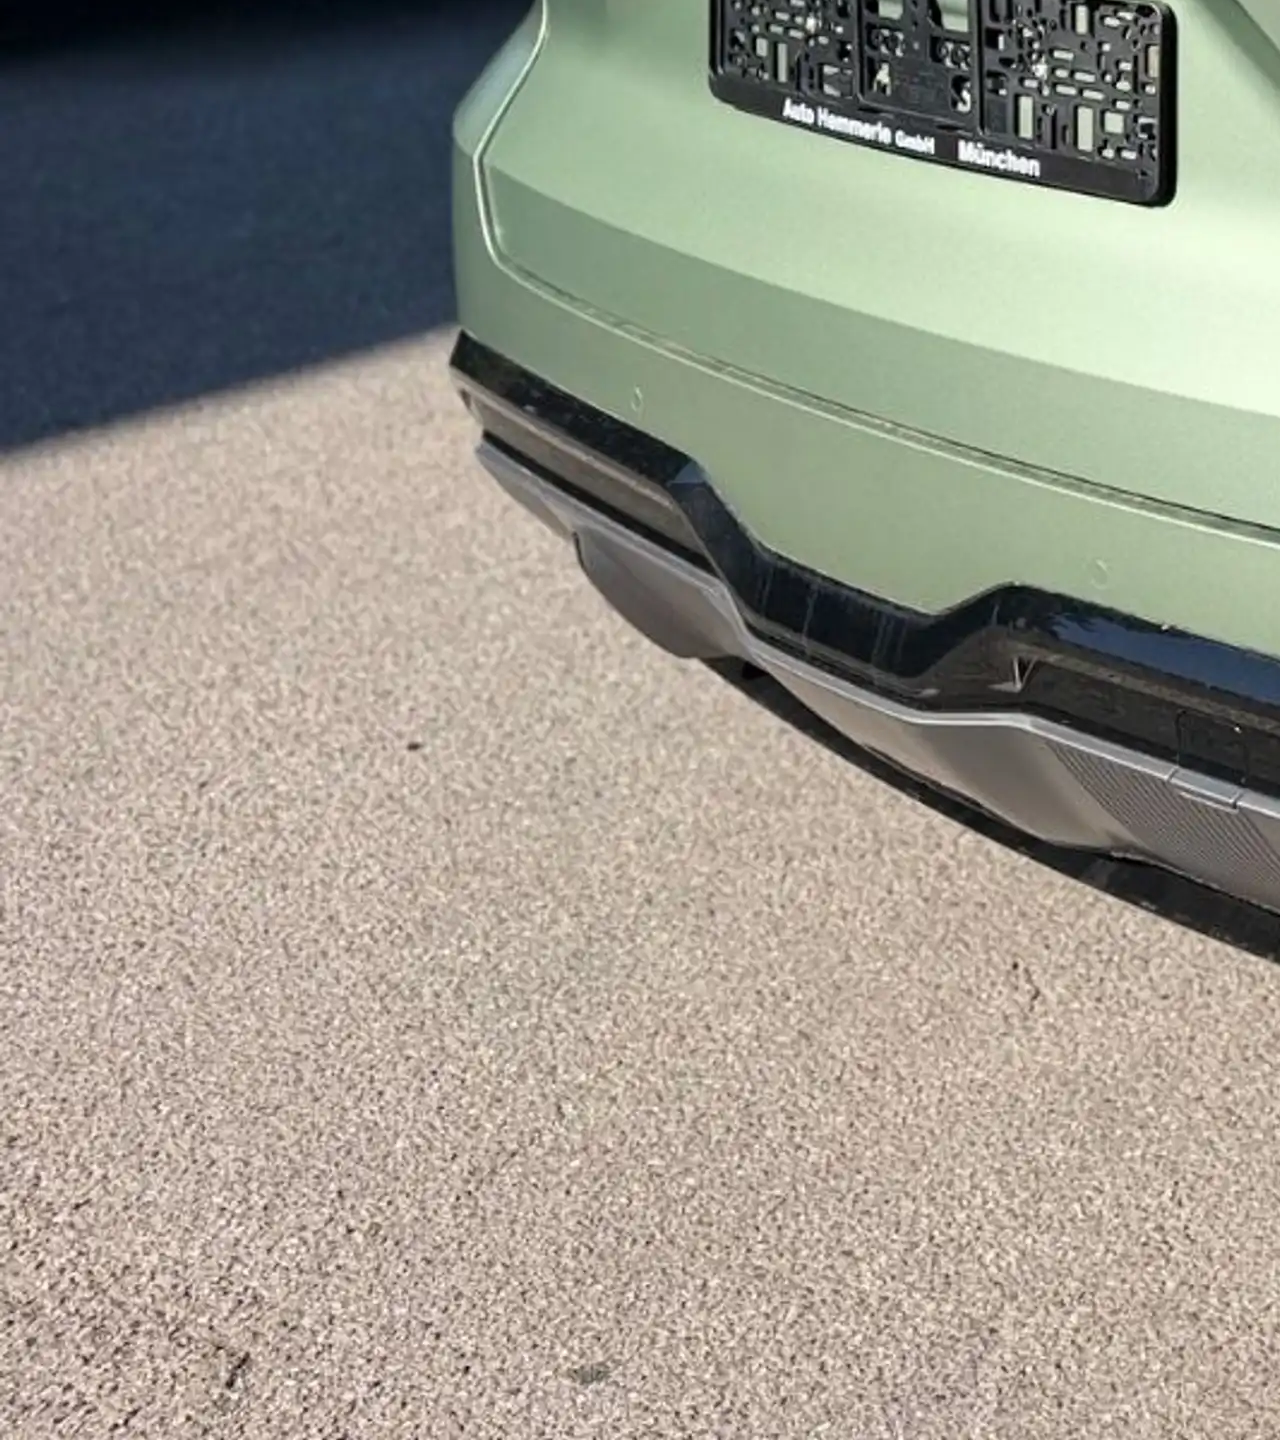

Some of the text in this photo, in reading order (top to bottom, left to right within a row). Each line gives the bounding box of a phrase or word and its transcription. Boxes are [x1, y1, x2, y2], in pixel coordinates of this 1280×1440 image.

[782, 97, 815, 125] Auto
[895, 129, 935, 155] GmbH
[957, 140, 1041, 177] München
